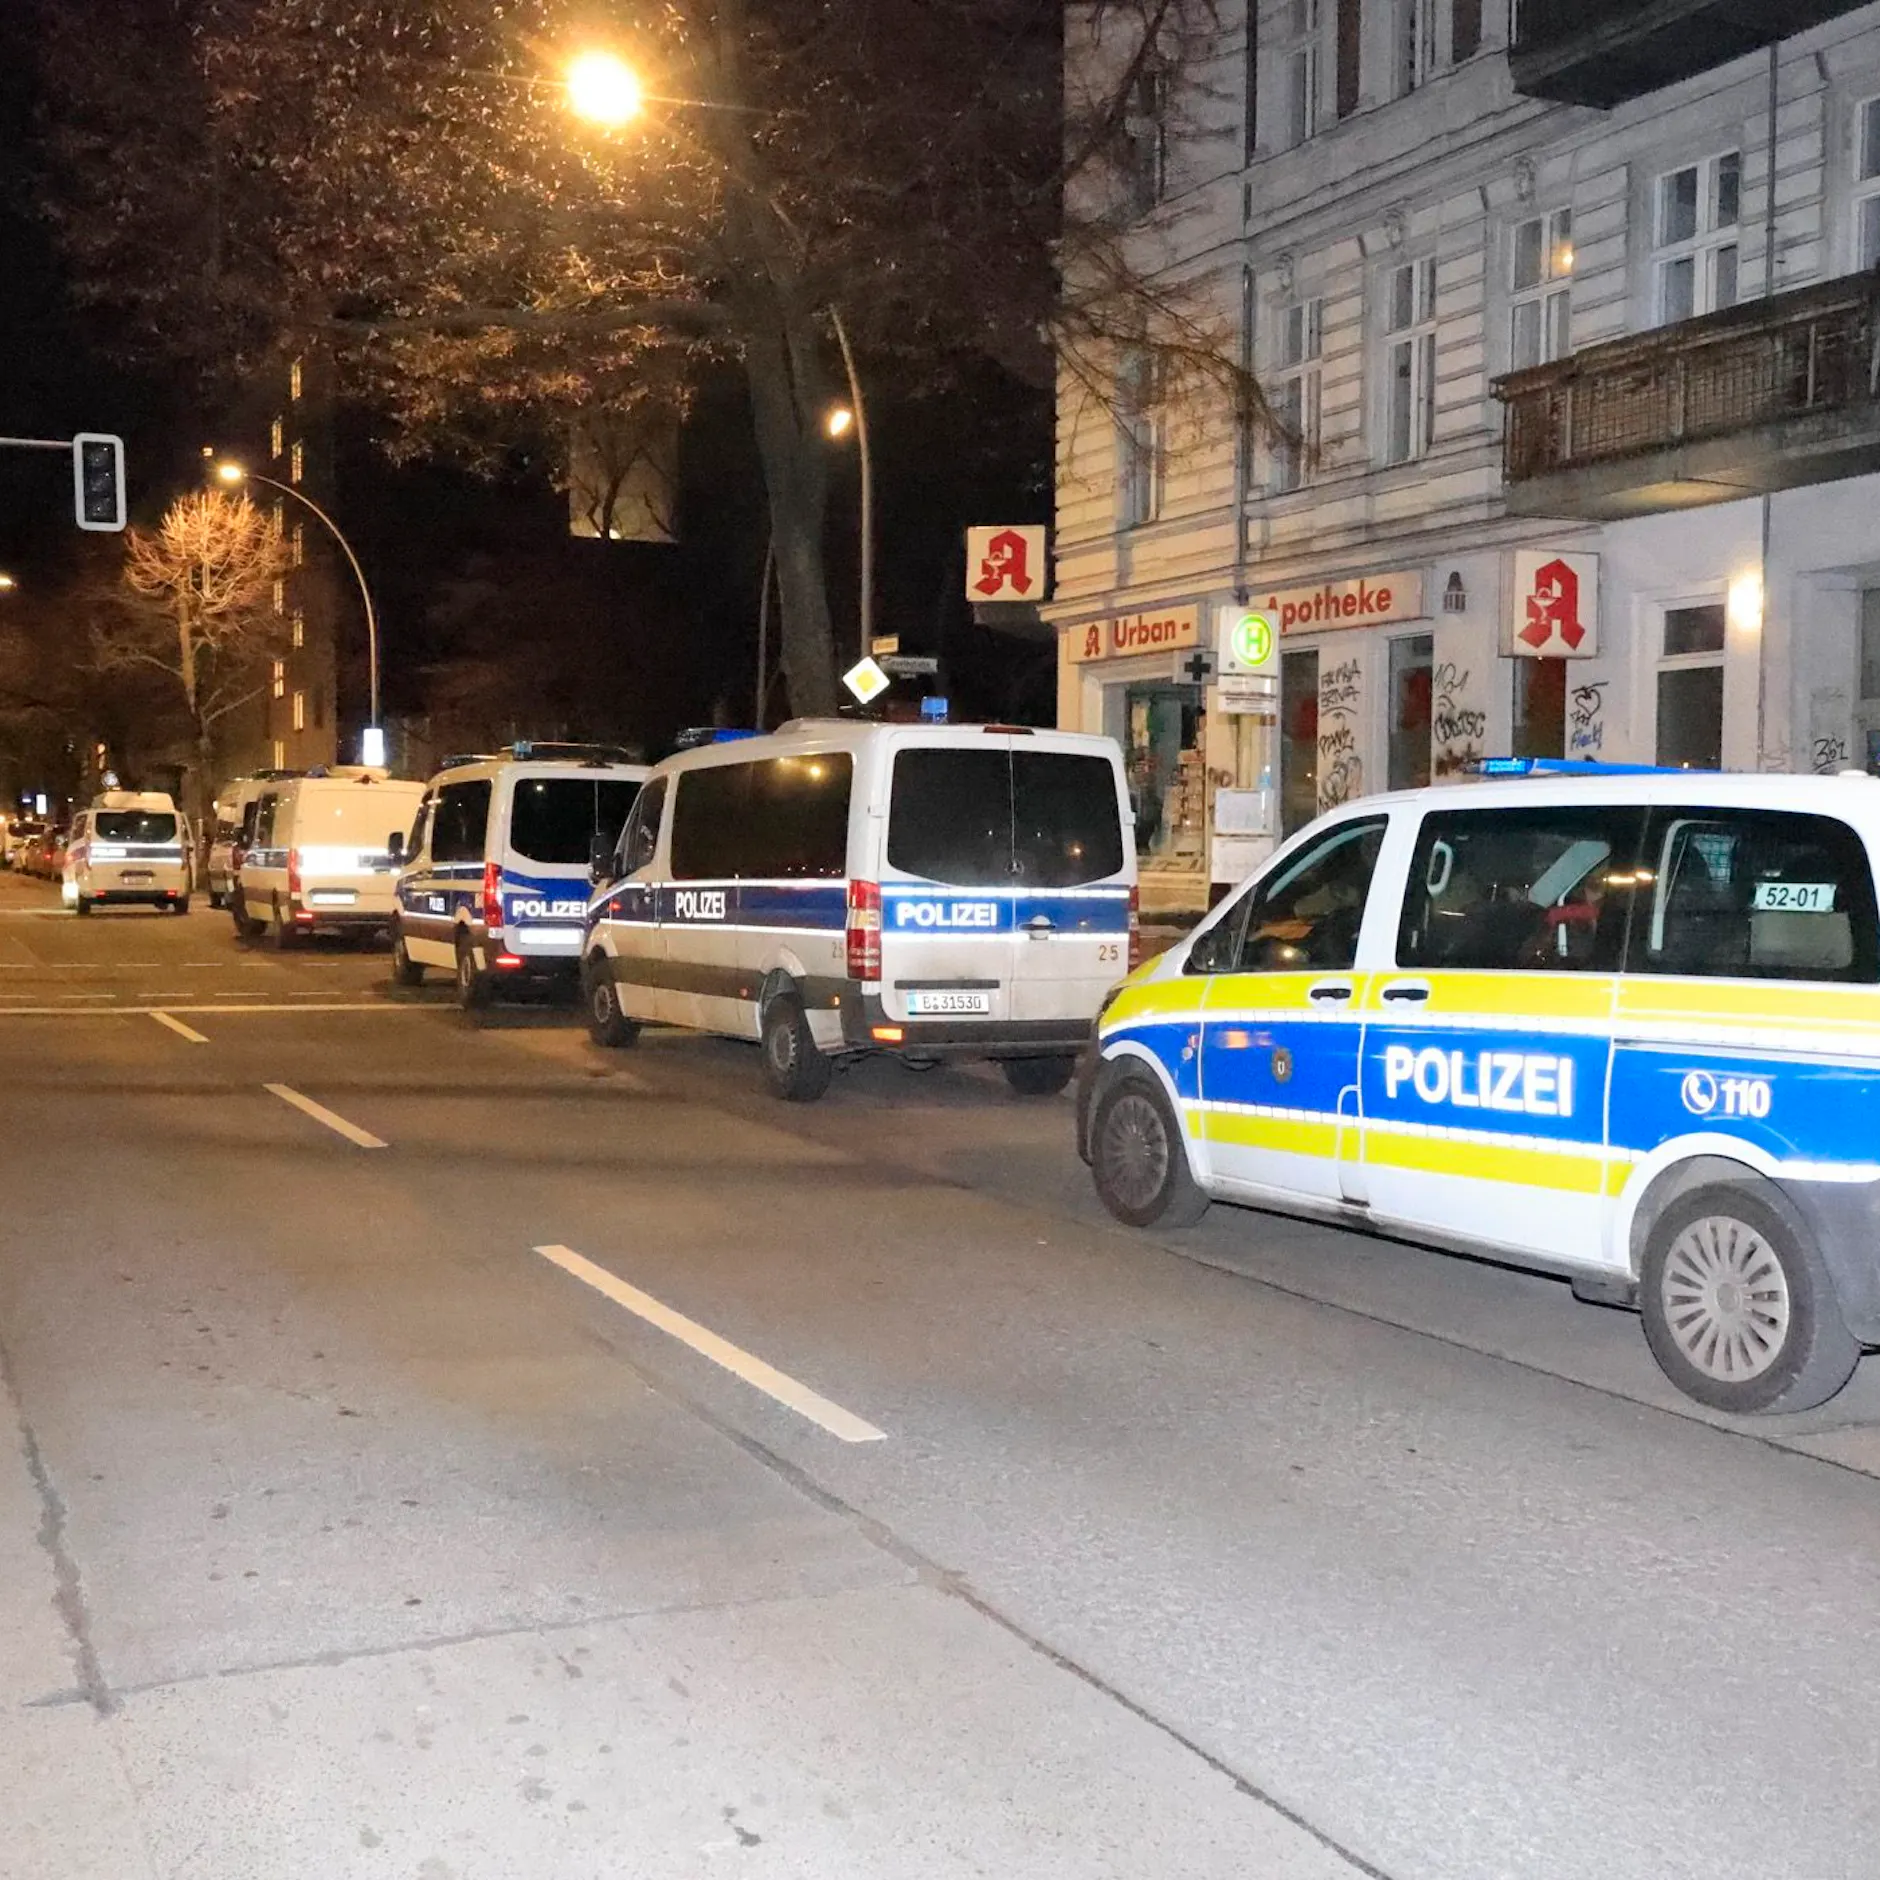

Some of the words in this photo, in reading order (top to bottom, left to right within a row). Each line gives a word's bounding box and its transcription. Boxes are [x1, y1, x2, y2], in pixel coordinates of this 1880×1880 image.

[512, 900, 587, 917] POLIZEI
[675, 891, 725, 919] POLIZEI
[1765, 887, 1820, 908] 52-01
[897, 902, 998, 927] POLIZEI
[1099, 945, 1119, 961] 25
[941, 996, 982, 1009] 31530
[1385, 1045, 1575, 1118] POLIZEI
[1721, 1079, 1772, 1118] 110
